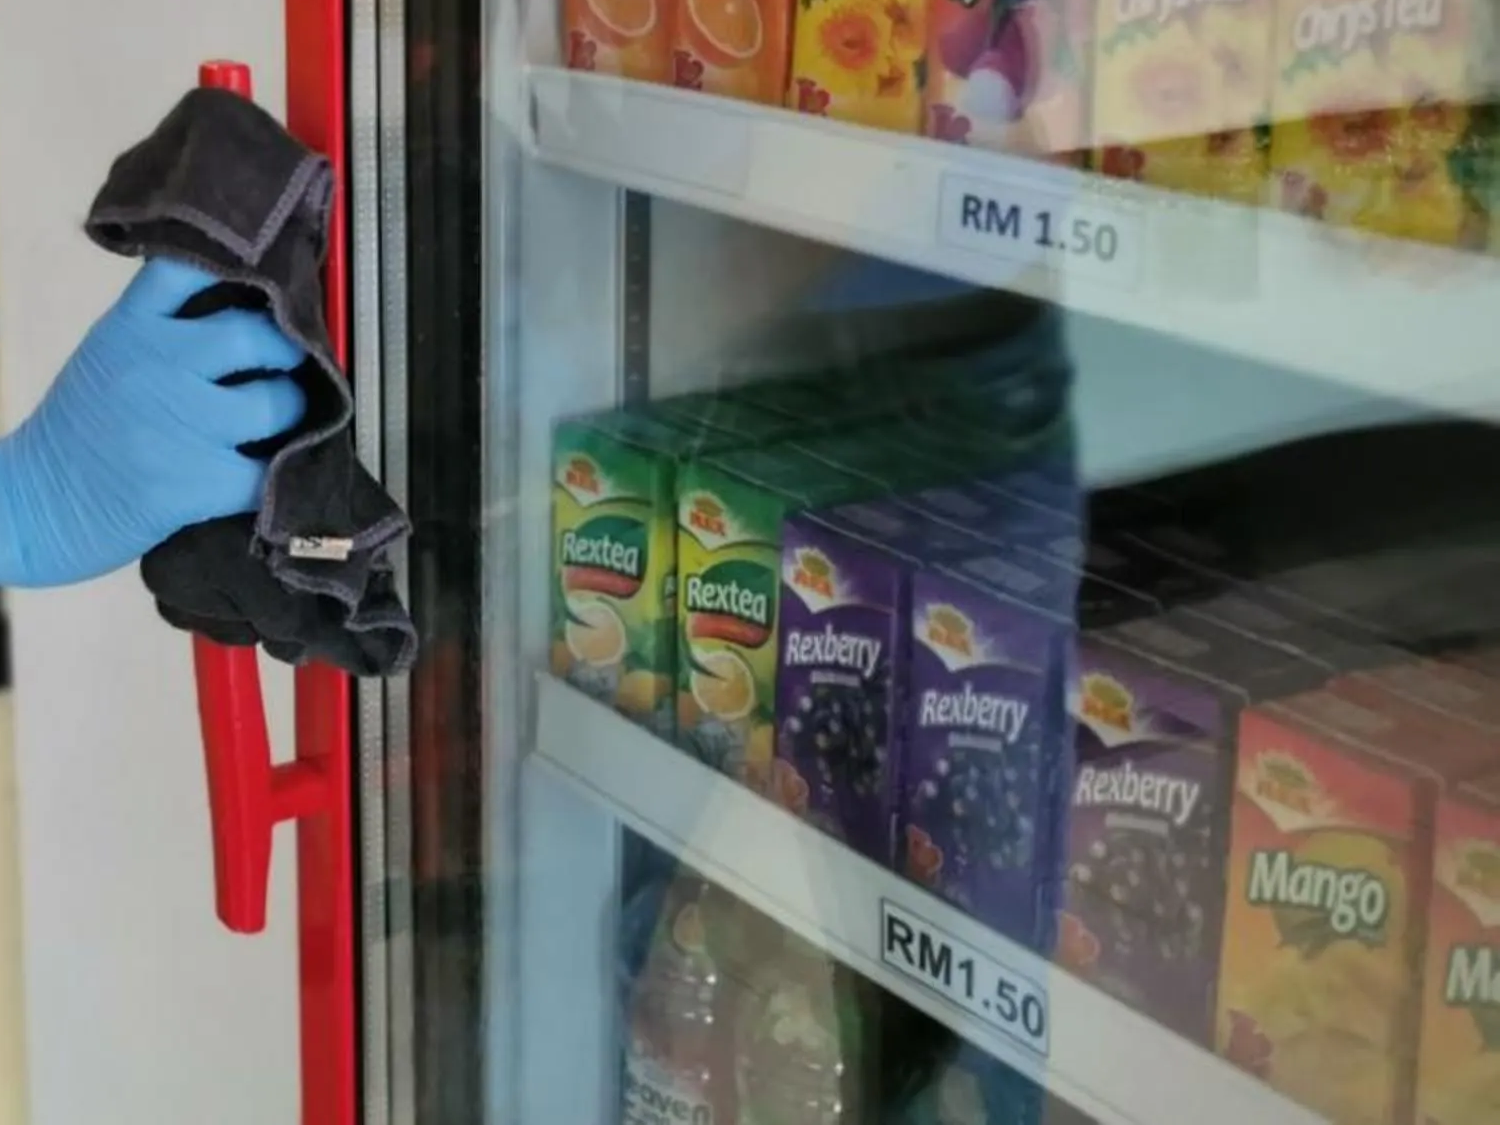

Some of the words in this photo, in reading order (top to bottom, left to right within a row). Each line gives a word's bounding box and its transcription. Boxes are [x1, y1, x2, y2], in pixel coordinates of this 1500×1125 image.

[961, 193, 1021, 240] RM
[1034, 212, 1118, 263] 1.50
[563, 531, 639, 576] Rextea
[687, 576, 768, 625] Rextea
[786, 622, 882, 679] Rexberry
[920, 681, 1029, 744] Rexberry
[1075, 760, 1199, 826] Rexberry
[1248, 851, 1387, 934] Mango
[886, 912, 1045, 1039] RM1.50
[1446, 946, 1500, 1002] M
